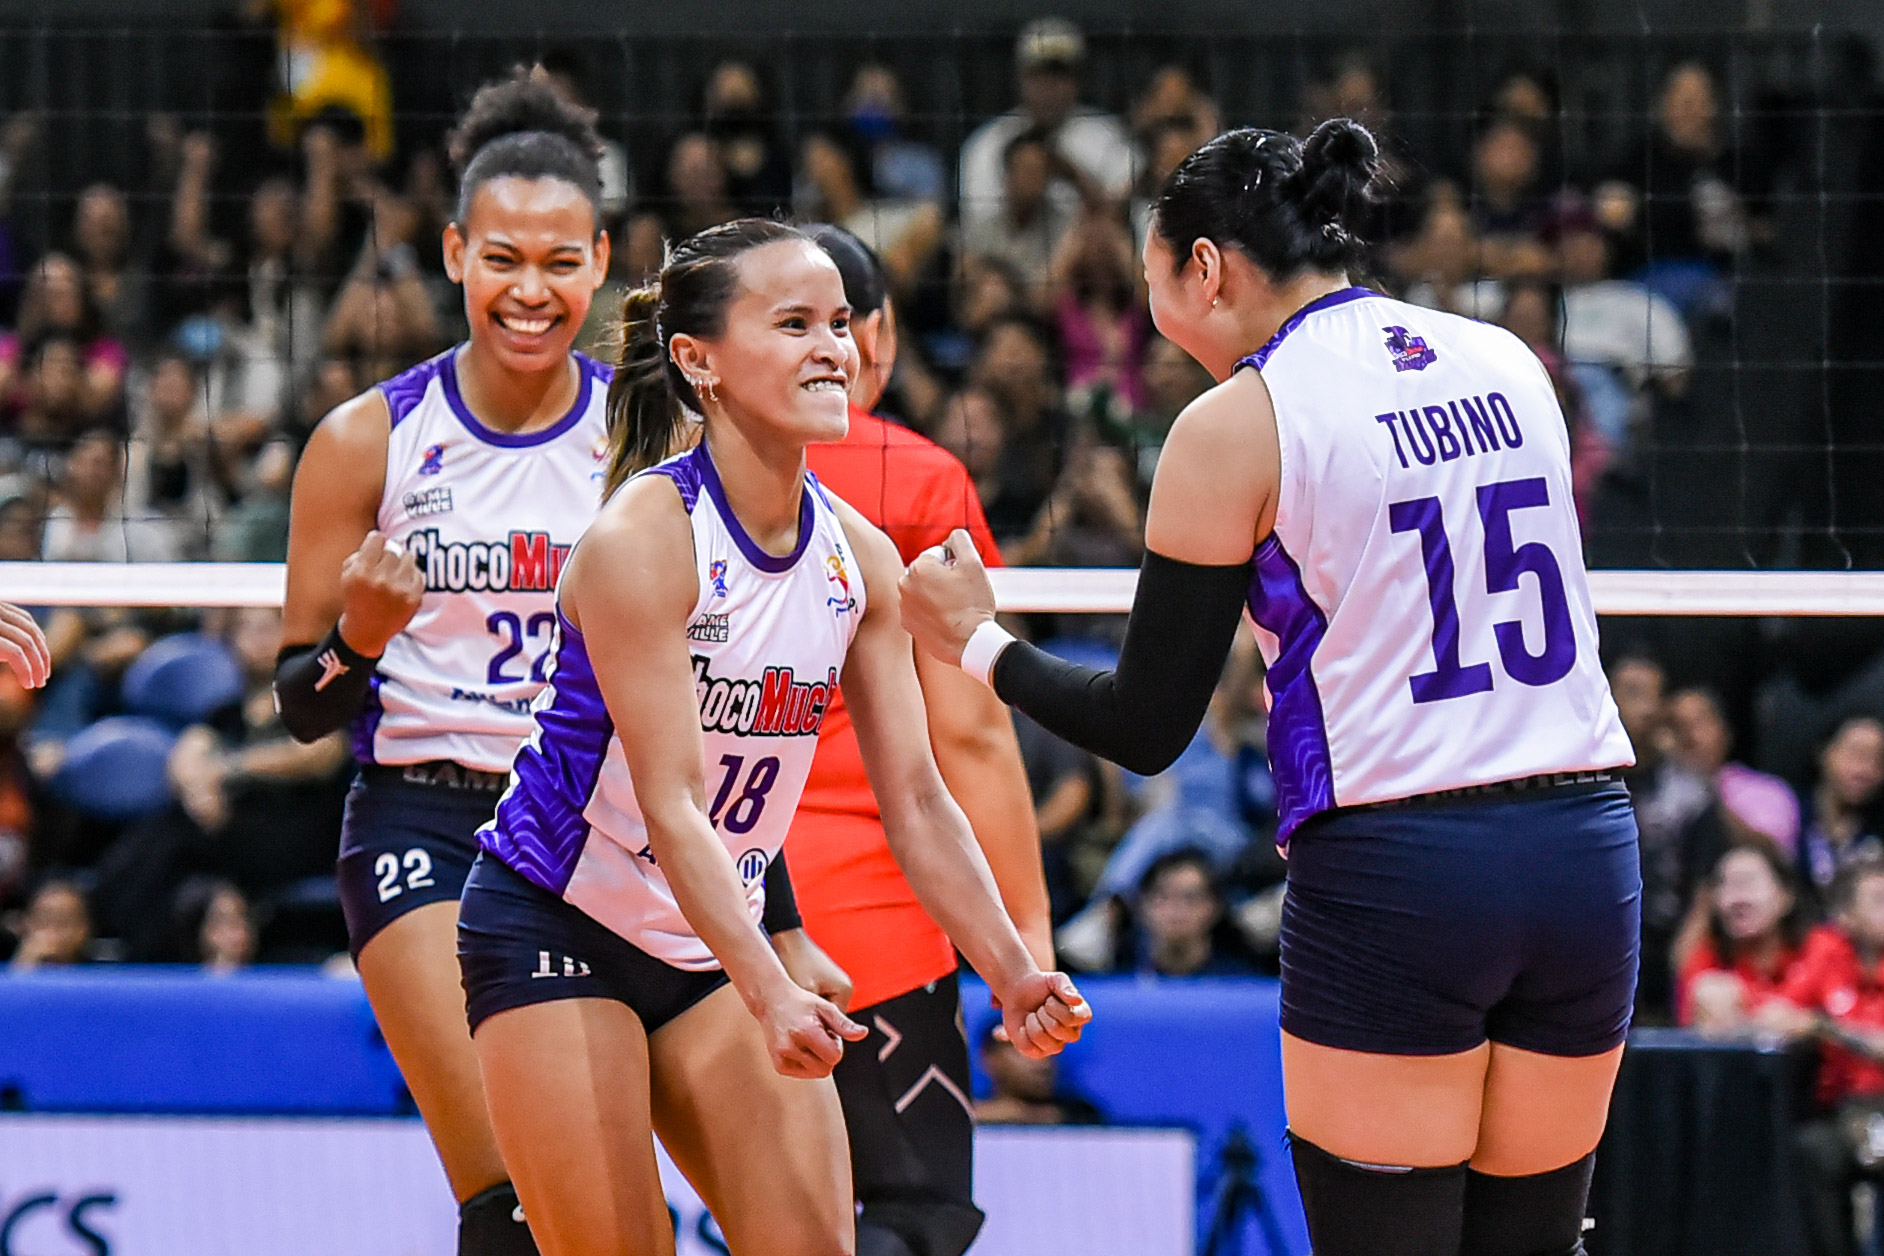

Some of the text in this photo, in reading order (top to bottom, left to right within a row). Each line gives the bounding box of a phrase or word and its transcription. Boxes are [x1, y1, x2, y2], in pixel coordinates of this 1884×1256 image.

[1375, 391, 1524, 469] TUBINO
[694, 613, 729, 628] AME
[1388, 476, 1577, 704] 15
[486, 611, 556, 685] 22
[708, 753, 780, 834] 18
[374, 847, 435, 903] 22
